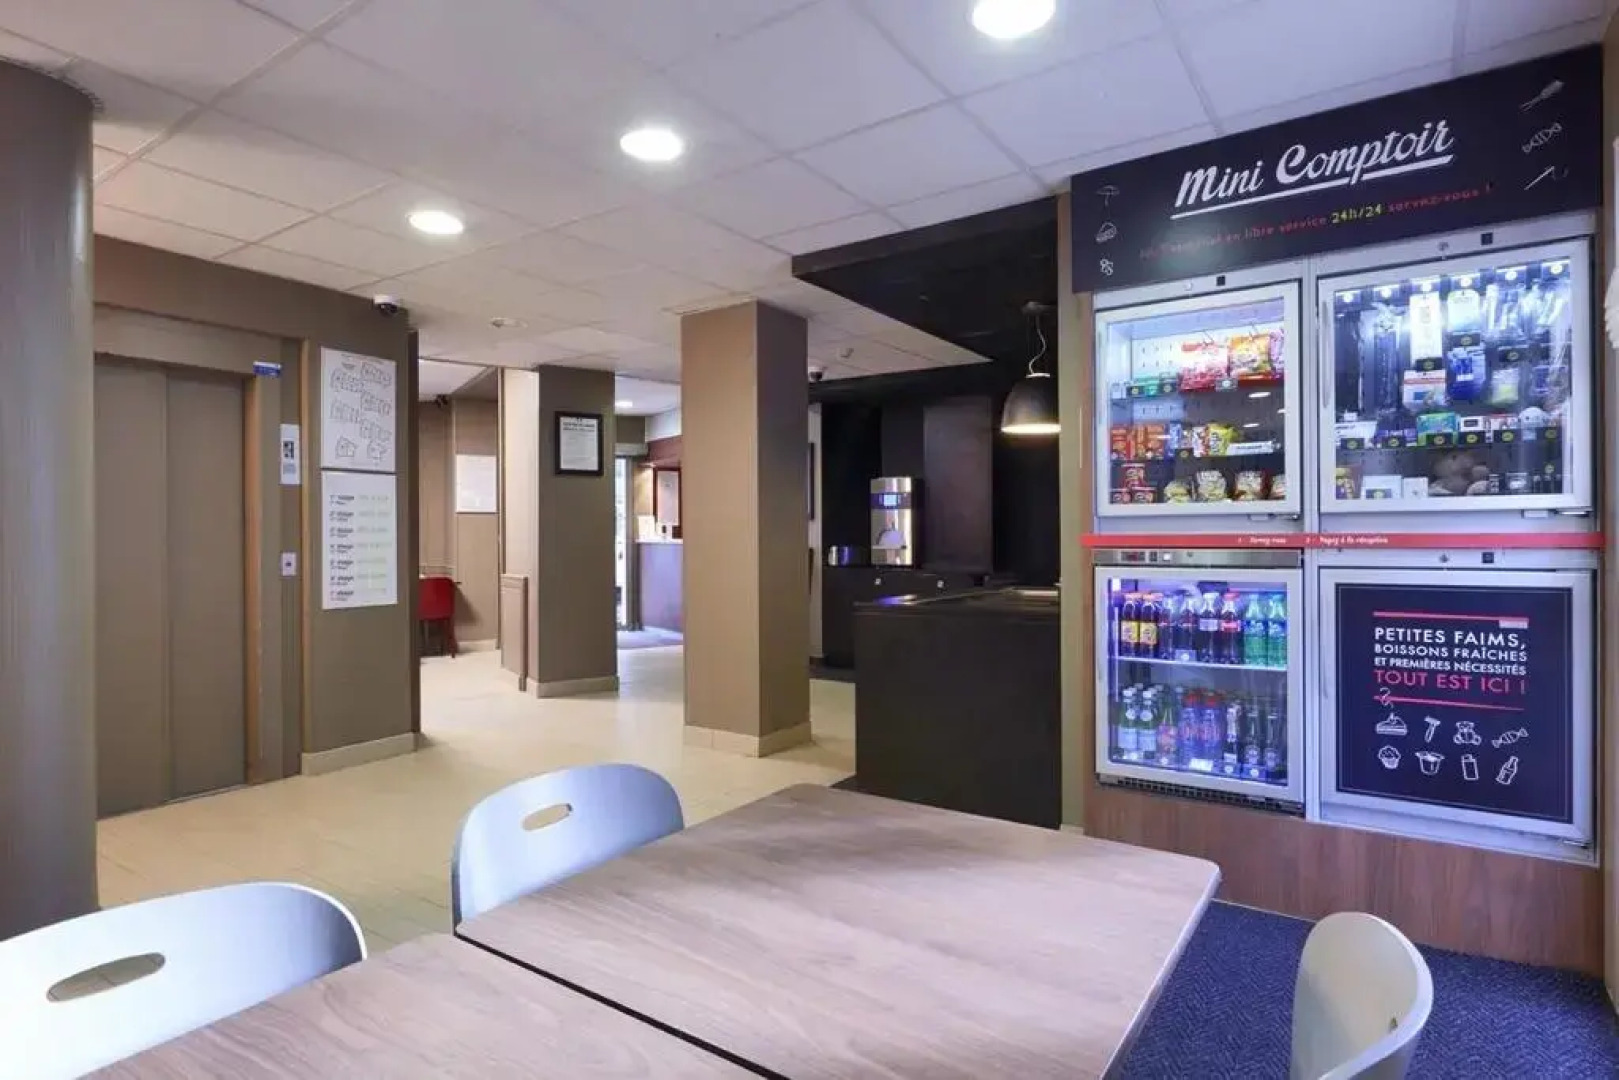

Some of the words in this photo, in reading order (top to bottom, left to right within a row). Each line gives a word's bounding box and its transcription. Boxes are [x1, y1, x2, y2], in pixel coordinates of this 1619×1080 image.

[1174, 160, 1264, 208] Mini
[1275, 120, 1454, 185] Comptoir
[1279, 216, 1327, 233] service
[1331, 203, 1383, 224] 24h/24
[1374, 627, 1446, 644] PETITES
[1454, 630, 1527, 650] FAIMS,
[1374, 643, 1449, 657] BOISSONS
[1453, 646, 1528, 662] FRAÎCHES
[1374, 657, 1386, 667] ET
[1389, 656, 1451, 671] PREMIÈRES
[1454, 660, 1527, 676] NÉCESSITÉS
[1374, 669, 1428, 687] TOUT
[1436, 673, 1473, 690] EST
[1481, 677, 1510, 694] ICI
